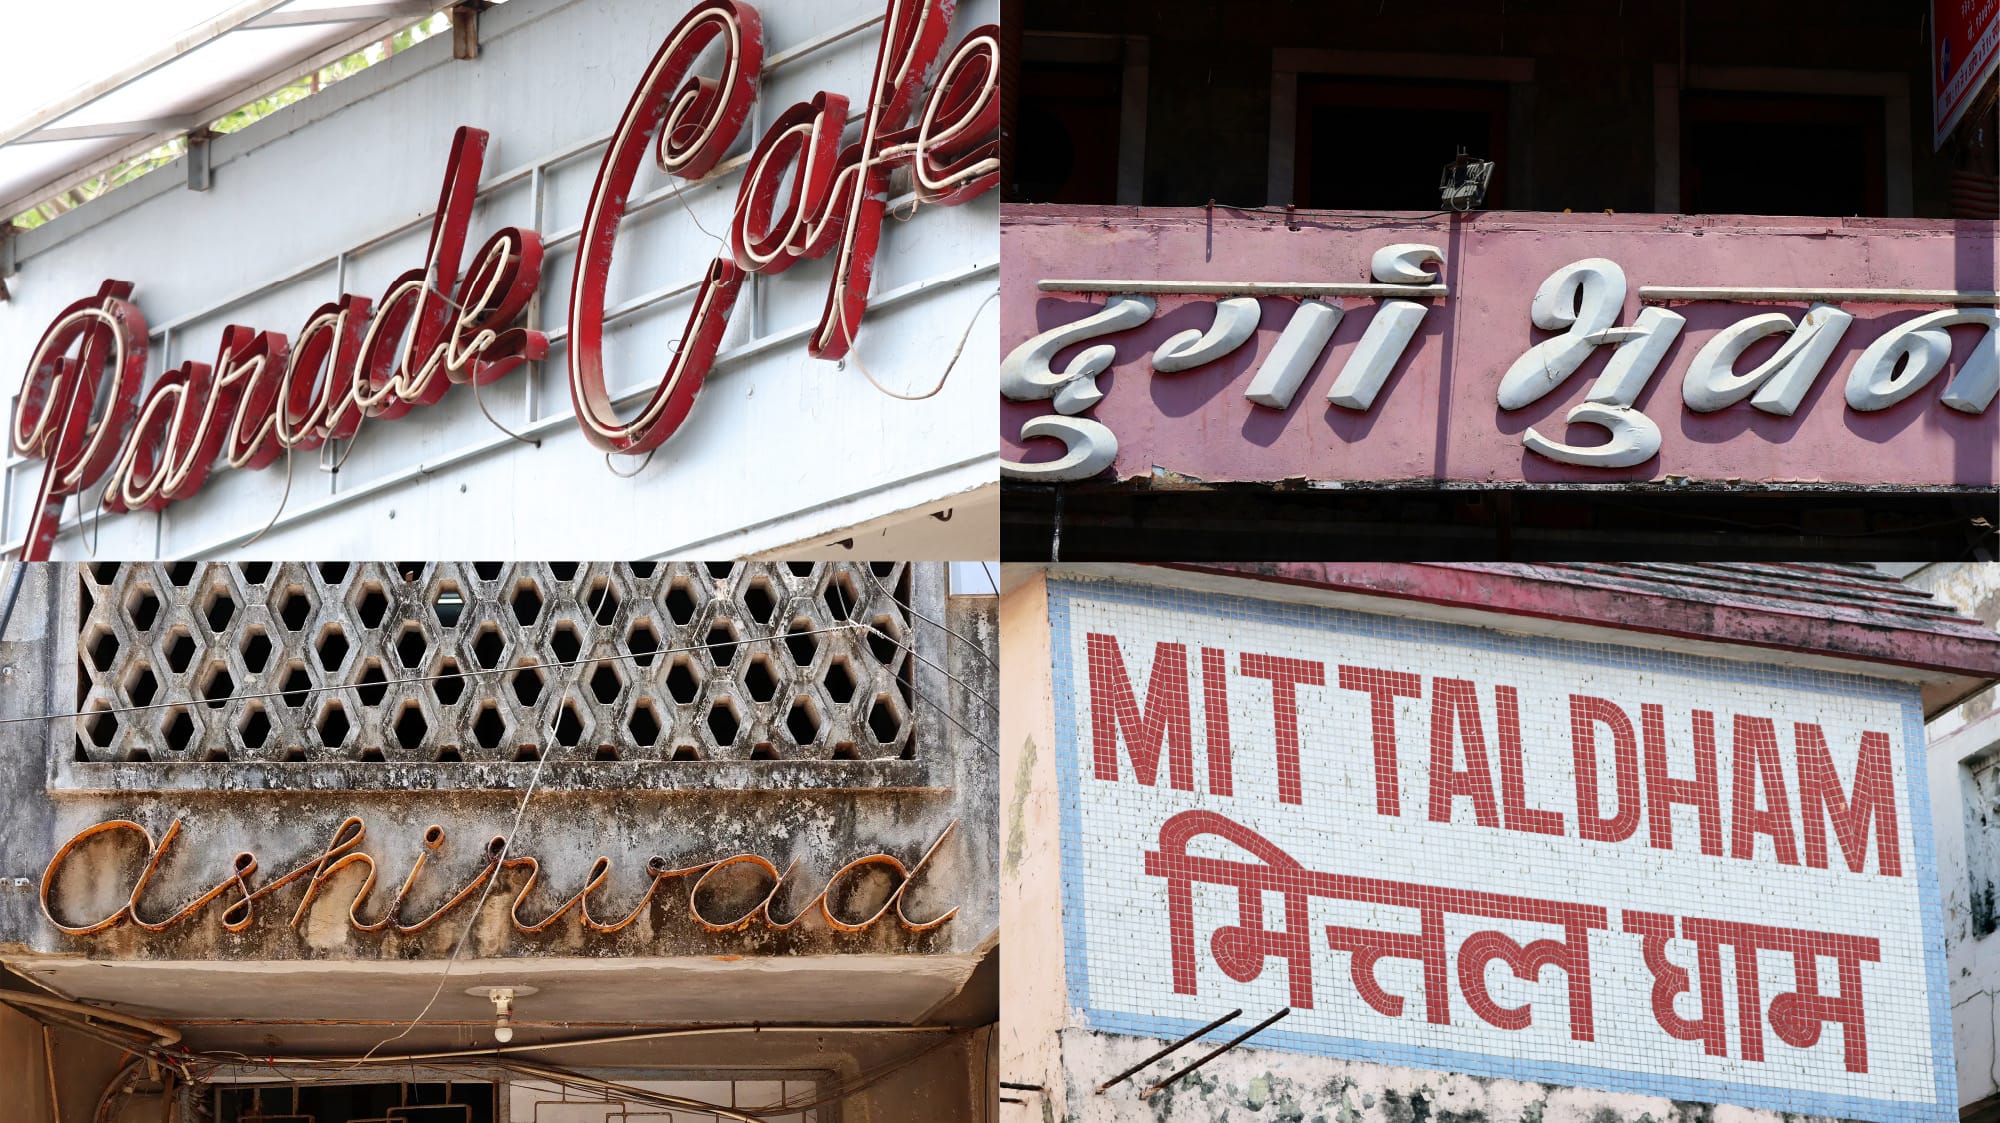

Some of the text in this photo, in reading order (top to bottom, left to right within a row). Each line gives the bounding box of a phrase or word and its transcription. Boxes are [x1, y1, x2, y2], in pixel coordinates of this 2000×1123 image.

[12, 0, 999, 561] Parade Cafe
[1000, 243, 1449, 483] दुर्गा
